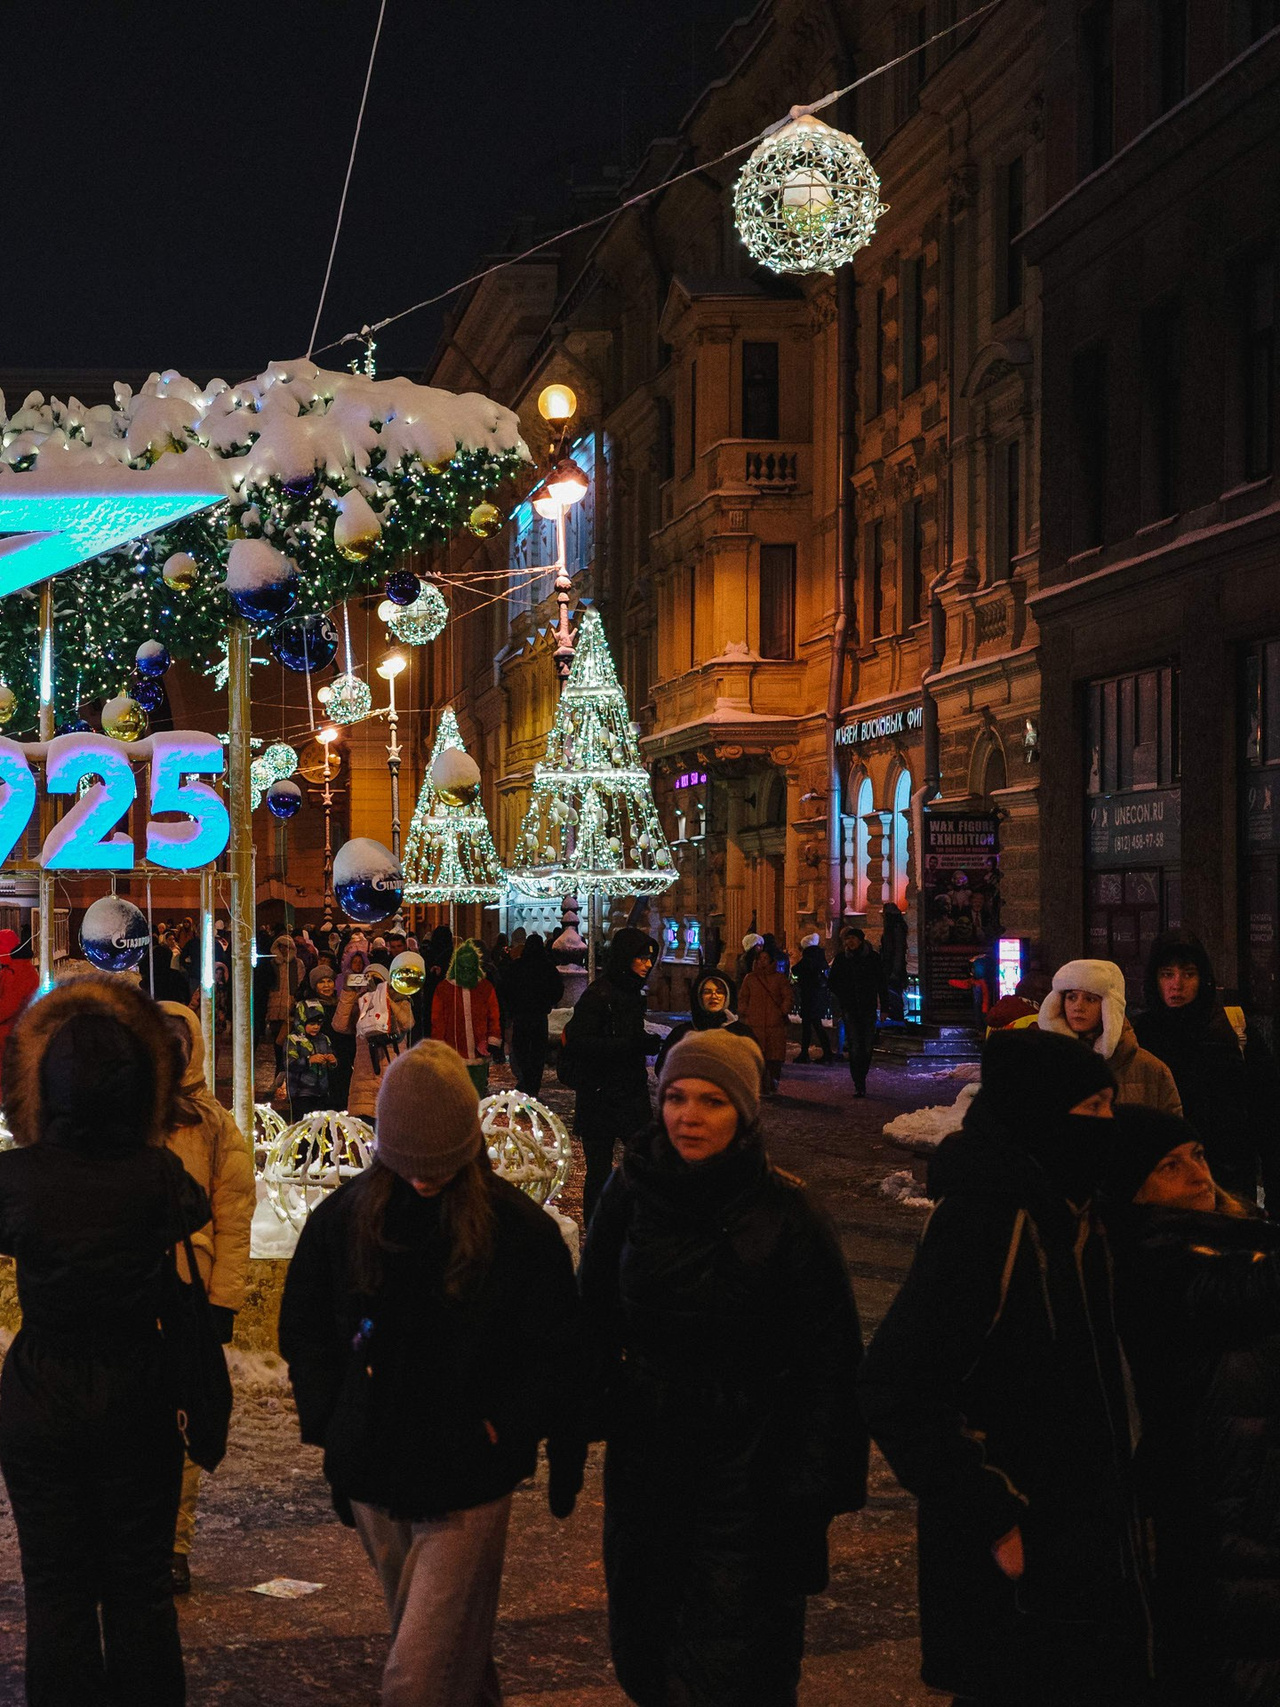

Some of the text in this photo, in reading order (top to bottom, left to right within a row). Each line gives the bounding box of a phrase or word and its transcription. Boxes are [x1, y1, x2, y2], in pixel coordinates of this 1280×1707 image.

[834, 724, 858, 747] МУЗЕЙ
[861, 711, 903, 741] ВОСКОВЫХ
[1114, 801, 1164, 826] UNECON.RU
[929, 820, 996, 832] WAX FIGURE
[930, 833, 995, 846] EXHIBITION
[1114, 834, 1131, 854] (812)
